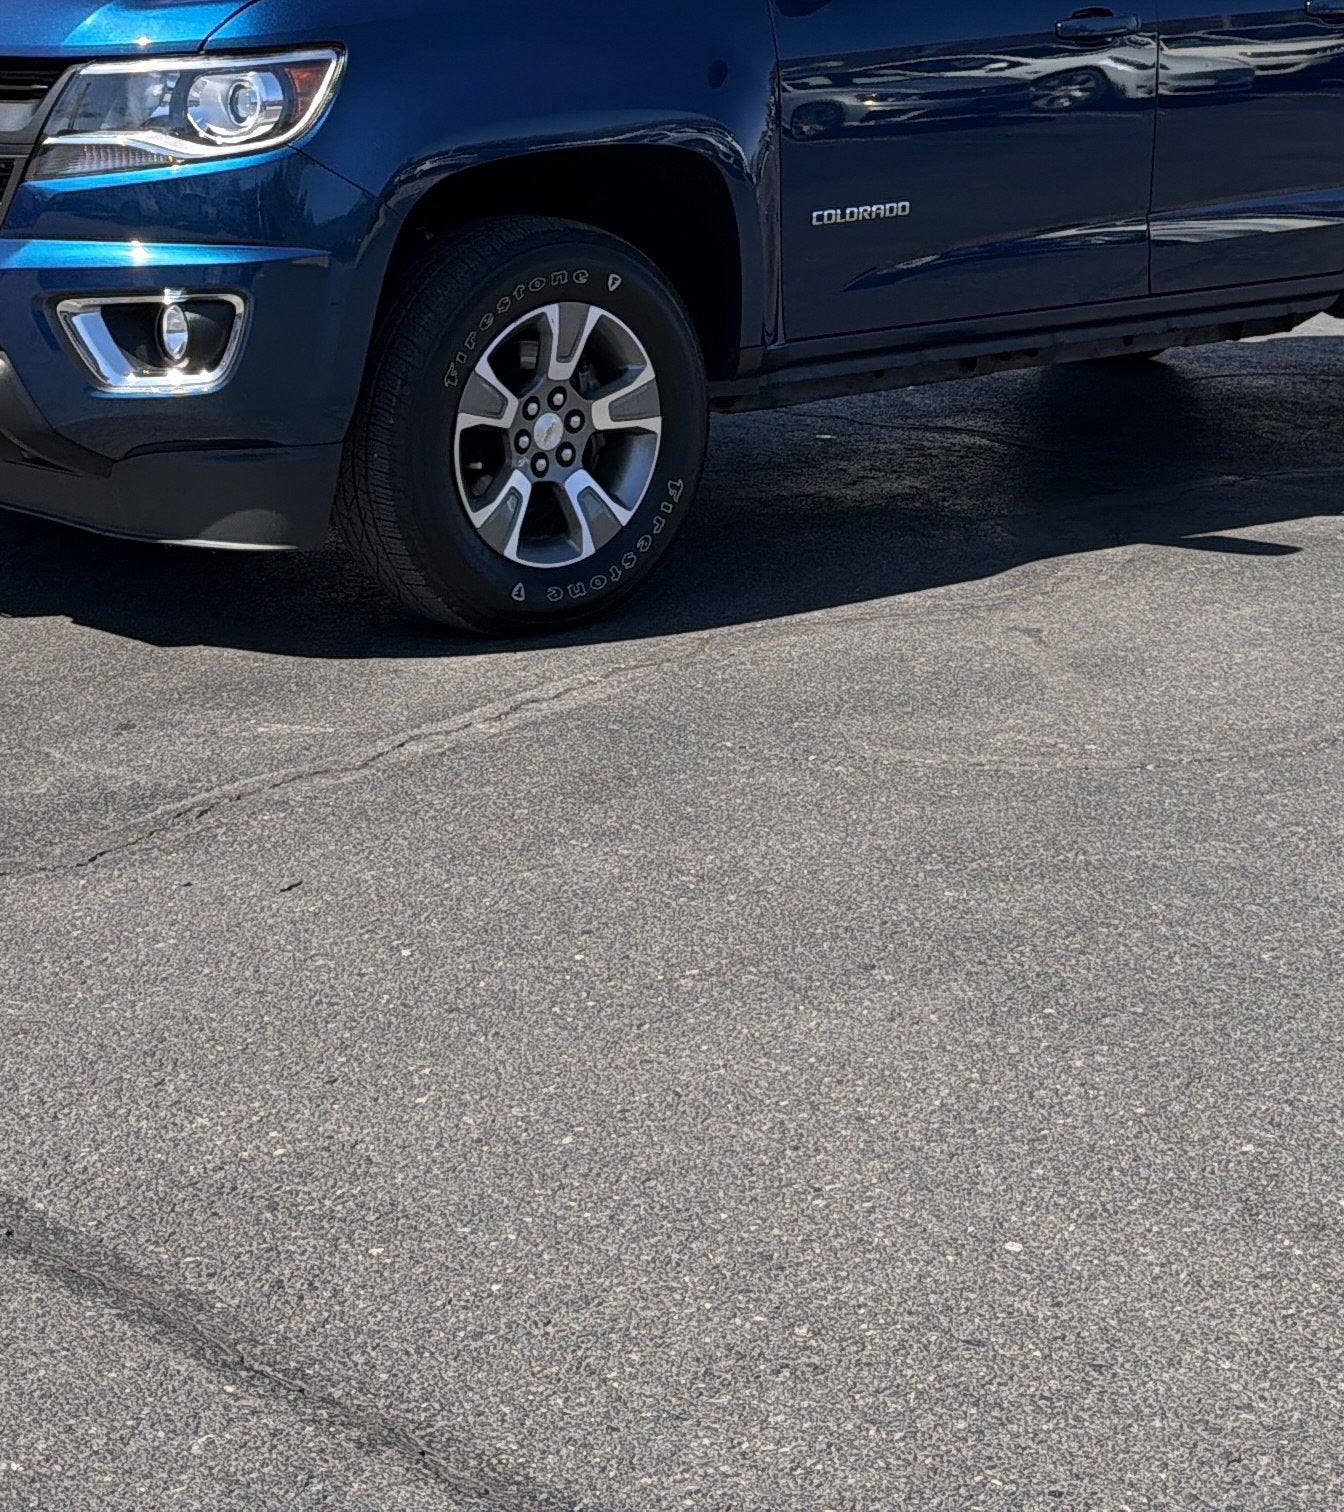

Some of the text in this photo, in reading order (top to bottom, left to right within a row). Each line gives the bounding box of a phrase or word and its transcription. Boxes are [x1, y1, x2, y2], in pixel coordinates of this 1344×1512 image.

[811, 201, 911, 226] COLORADO
[444, 270, 590, 388] Firestone
[547, 478, 684, 602] Firestone
